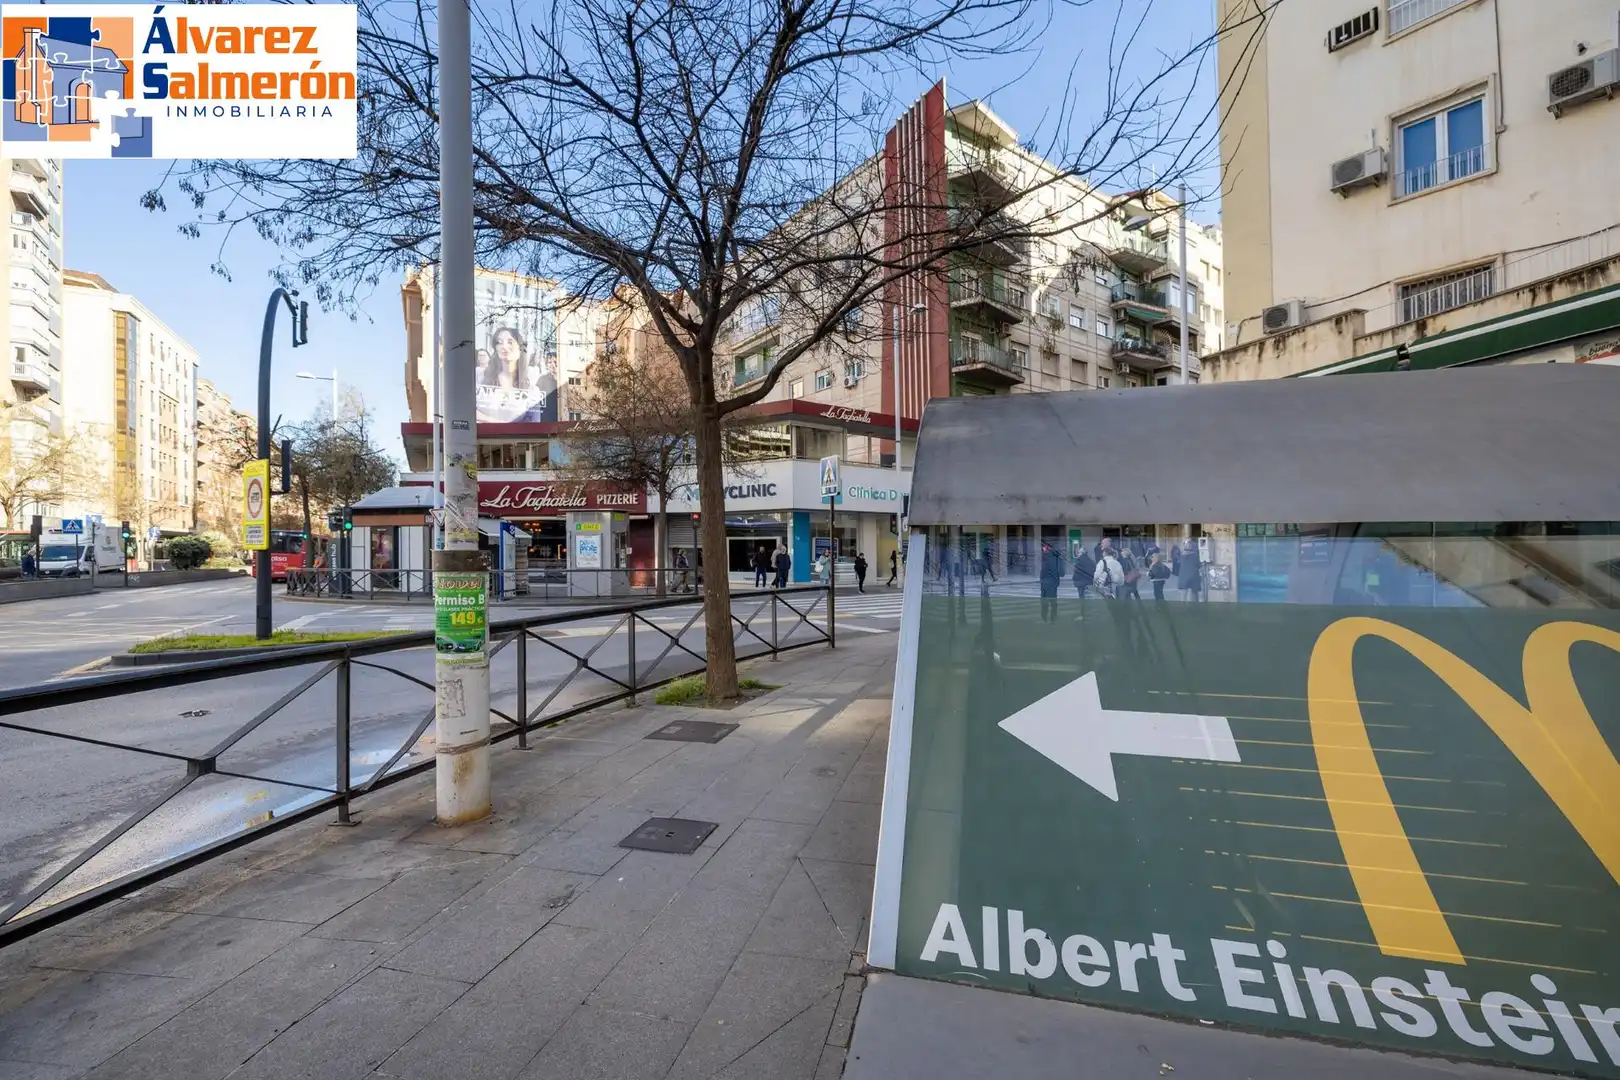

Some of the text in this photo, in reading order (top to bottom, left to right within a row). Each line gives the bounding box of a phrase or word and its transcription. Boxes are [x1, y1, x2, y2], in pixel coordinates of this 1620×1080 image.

[480, 485, 511, 507] La
[596, 493, 639, 505] PIZZERIE
[920, 903, 1197, 1003] Albert
